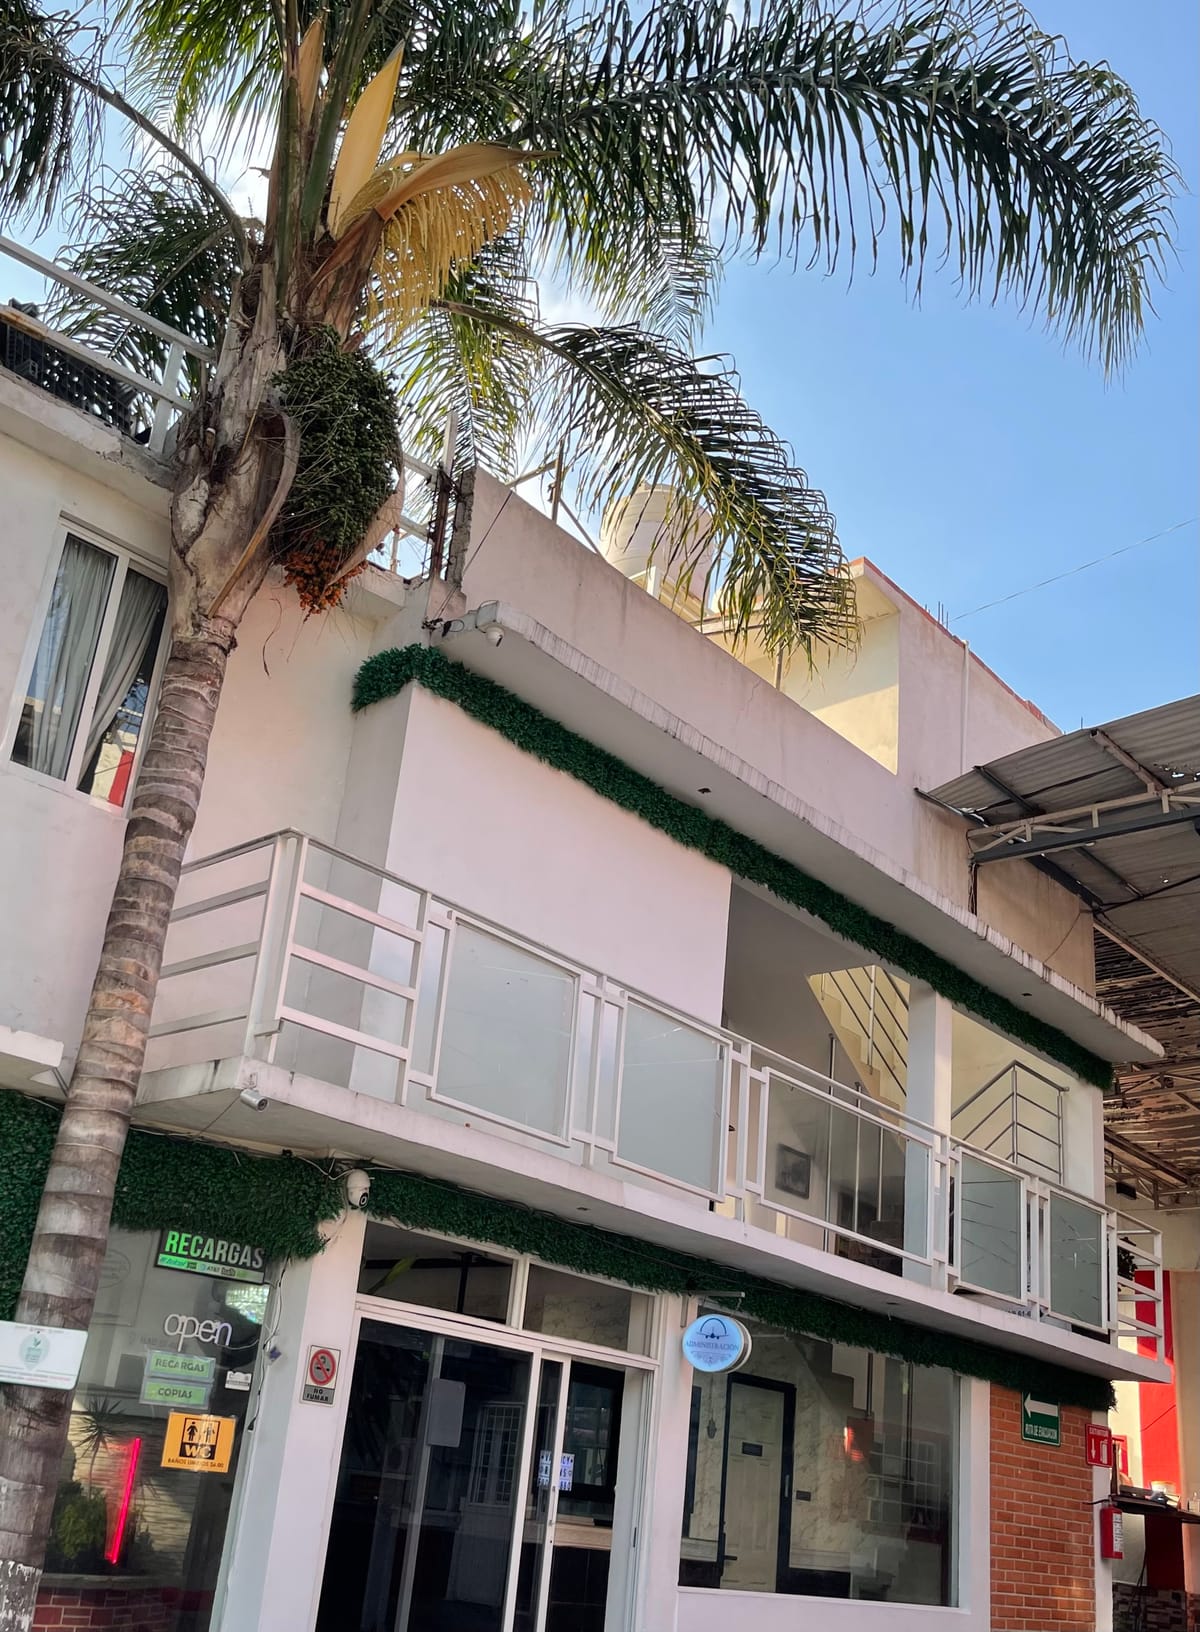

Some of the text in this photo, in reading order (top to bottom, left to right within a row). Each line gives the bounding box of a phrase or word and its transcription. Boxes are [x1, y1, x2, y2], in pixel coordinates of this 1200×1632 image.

[165, 1230, 265, 1269] RECARGAS
[164, 1313, 232, 1352] open
[155, 1358, 205, 1372] RECARGAS
[158, 1387, 193, 1399] COPIAS
[306, 1393, 329, 1402] FUMAR
[185, 1444, 212, 1459] WC
